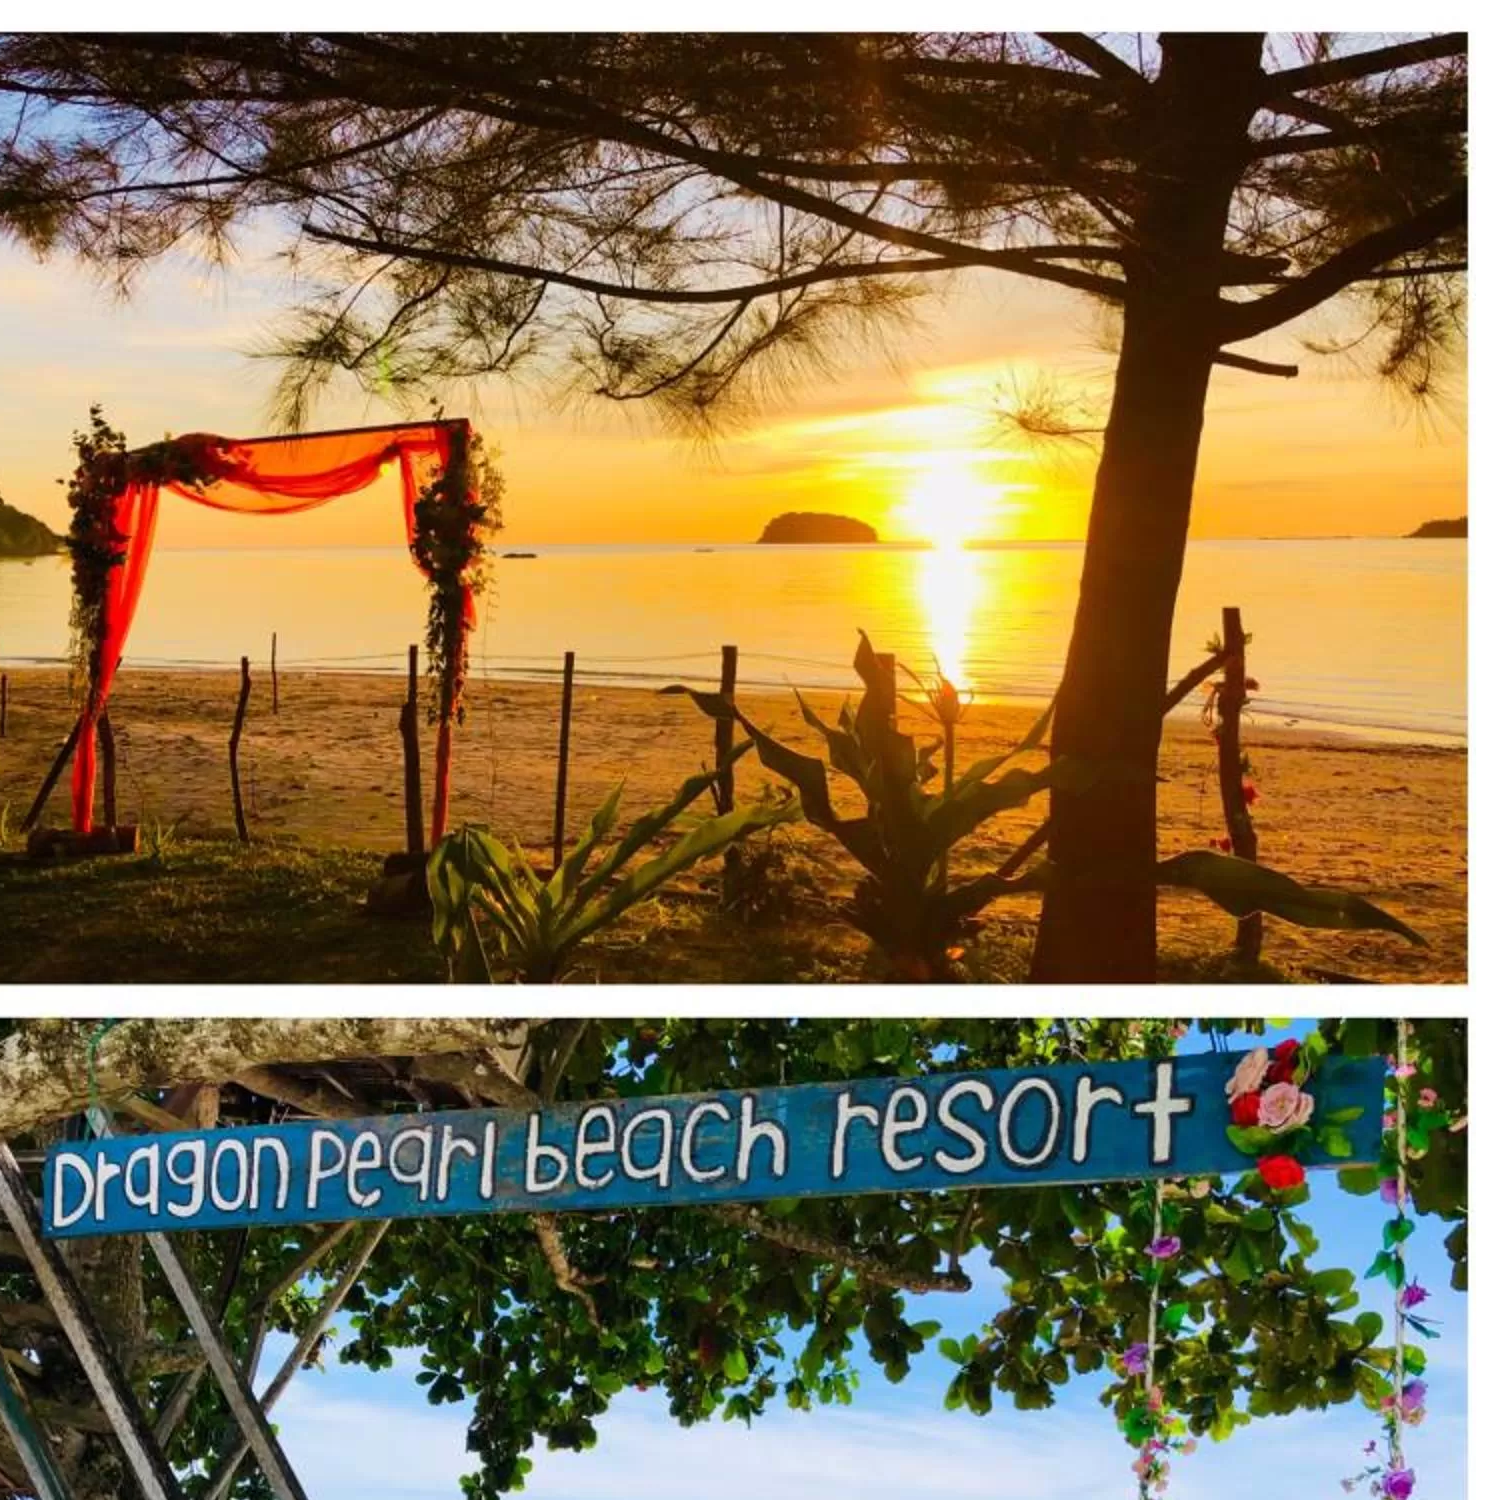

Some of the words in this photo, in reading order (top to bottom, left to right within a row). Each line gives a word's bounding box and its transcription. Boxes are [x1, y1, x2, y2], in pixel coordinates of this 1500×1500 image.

[52, 1136, 288, 1228] Dragon
[525, 1096, 787, 1193] beach
[832, 1060, 1192, 1179] resort
